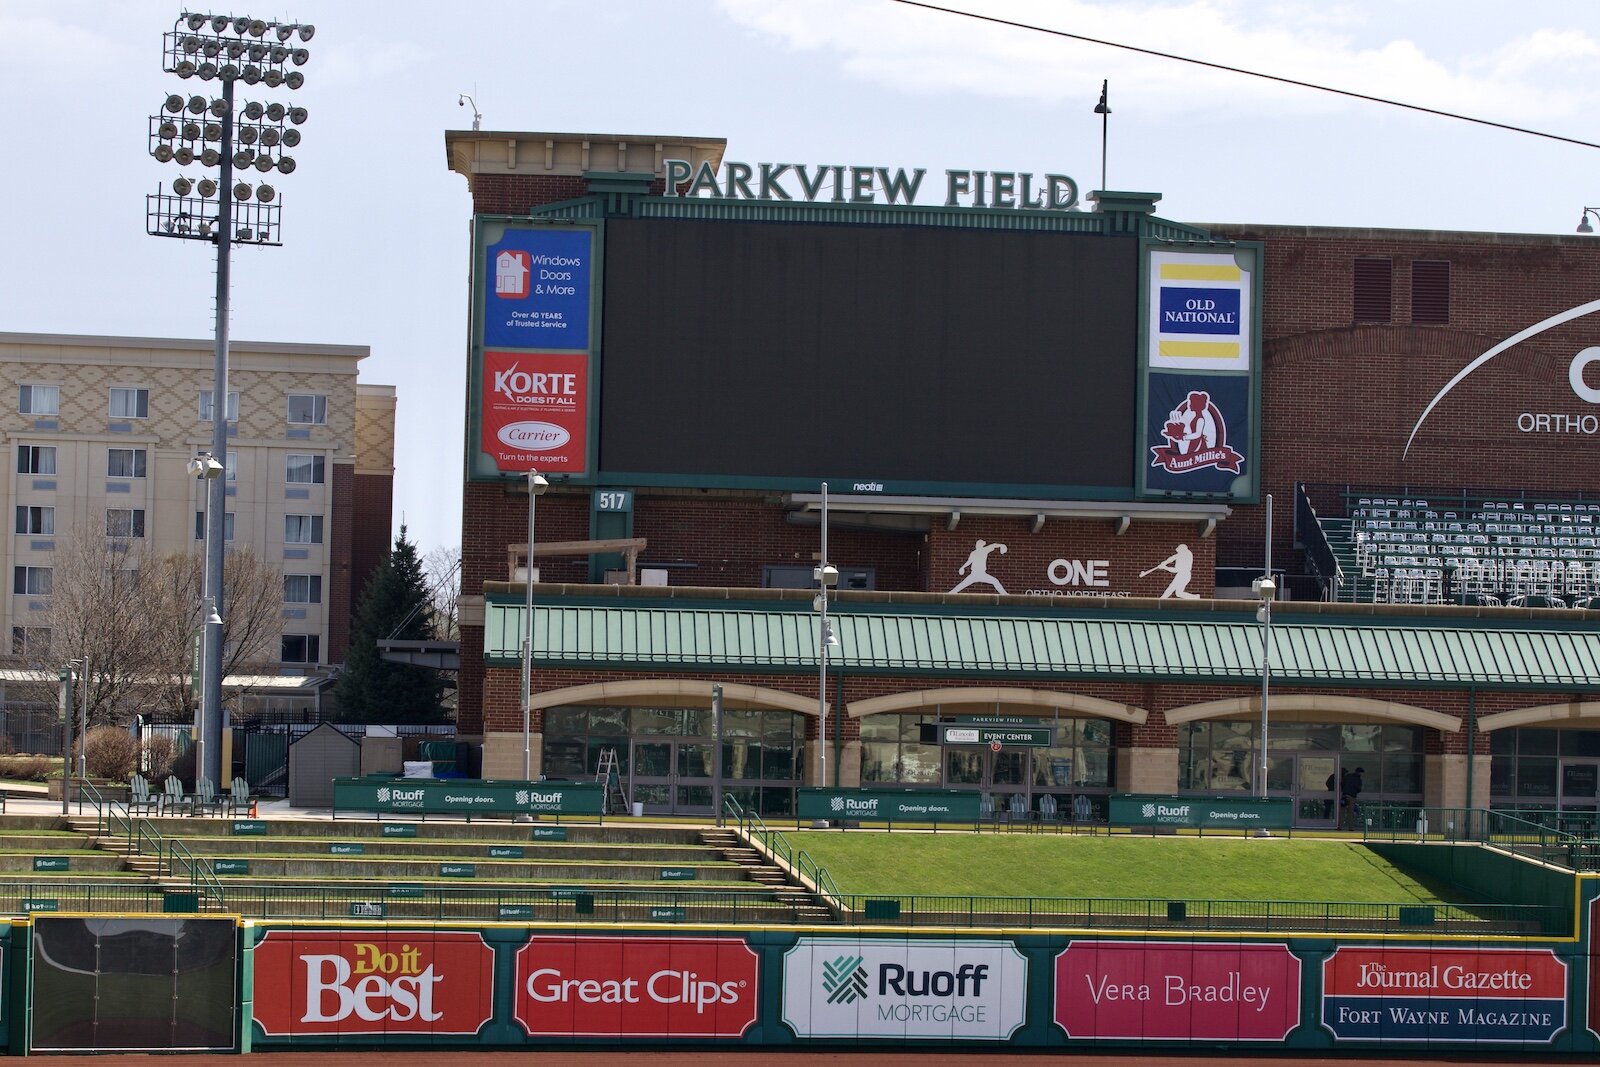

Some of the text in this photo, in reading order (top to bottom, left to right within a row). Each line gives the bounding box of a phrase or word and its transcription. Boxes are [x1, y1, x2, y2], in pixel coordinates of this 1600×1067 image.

[663, 159, 1080, 211] PARKVIEW FIELD
[532, 255, 580, 266] Windows
[540, 270, 571, 280] Doors
[535, 284, 576, 295] & More
[1186, 299, 1216, 310] OLD
[541, 312, 562, 320] YEARS
[1165, 311, 1235, 324] NATIONAL
[515, 320, 540, 328] Trusted
[494, 361, 577, 397] KORTE
[516, 396, 545, 404] DOES
[546, 396, 556, 404] IT
[1518, 412, 1599, 434] ORTHO
[508, 428, 560, 441] Carrier
[499, 452, 516, 460] Turn
[526, 454, 538, 462] the
[540, 455, 568, 463] experts
[1170, 450, 1226, 468] Aunt Millie's
[600, 492, 624, 510] 517
[1047, 558, 1110, 587] ONE
[392, 790, 424, 800] Ruoff
[444, 795, 472, 804] Opening
[530, 792, 562, 803] Ruoff
[846, 799, 878, 809] Ruoff
[898, 804, 927, 812] Opening
[1158, 805, 1190, 816] Ruoff
[1210, 811, 1238, 820] Opening
[1370, 962, 1386, 972] The
[878, 963, 989, 997] Ruoff
[1356, 964, 1532, 990] Journal Gazette
[300, 954, 444, 1022] Best
[526, 968, 640, 1003] Great
[878, 1004, 986, 1022] MORTGAGE
[1338, 1006, 1552, 1026] FORT WAYNE MAGAZINE
